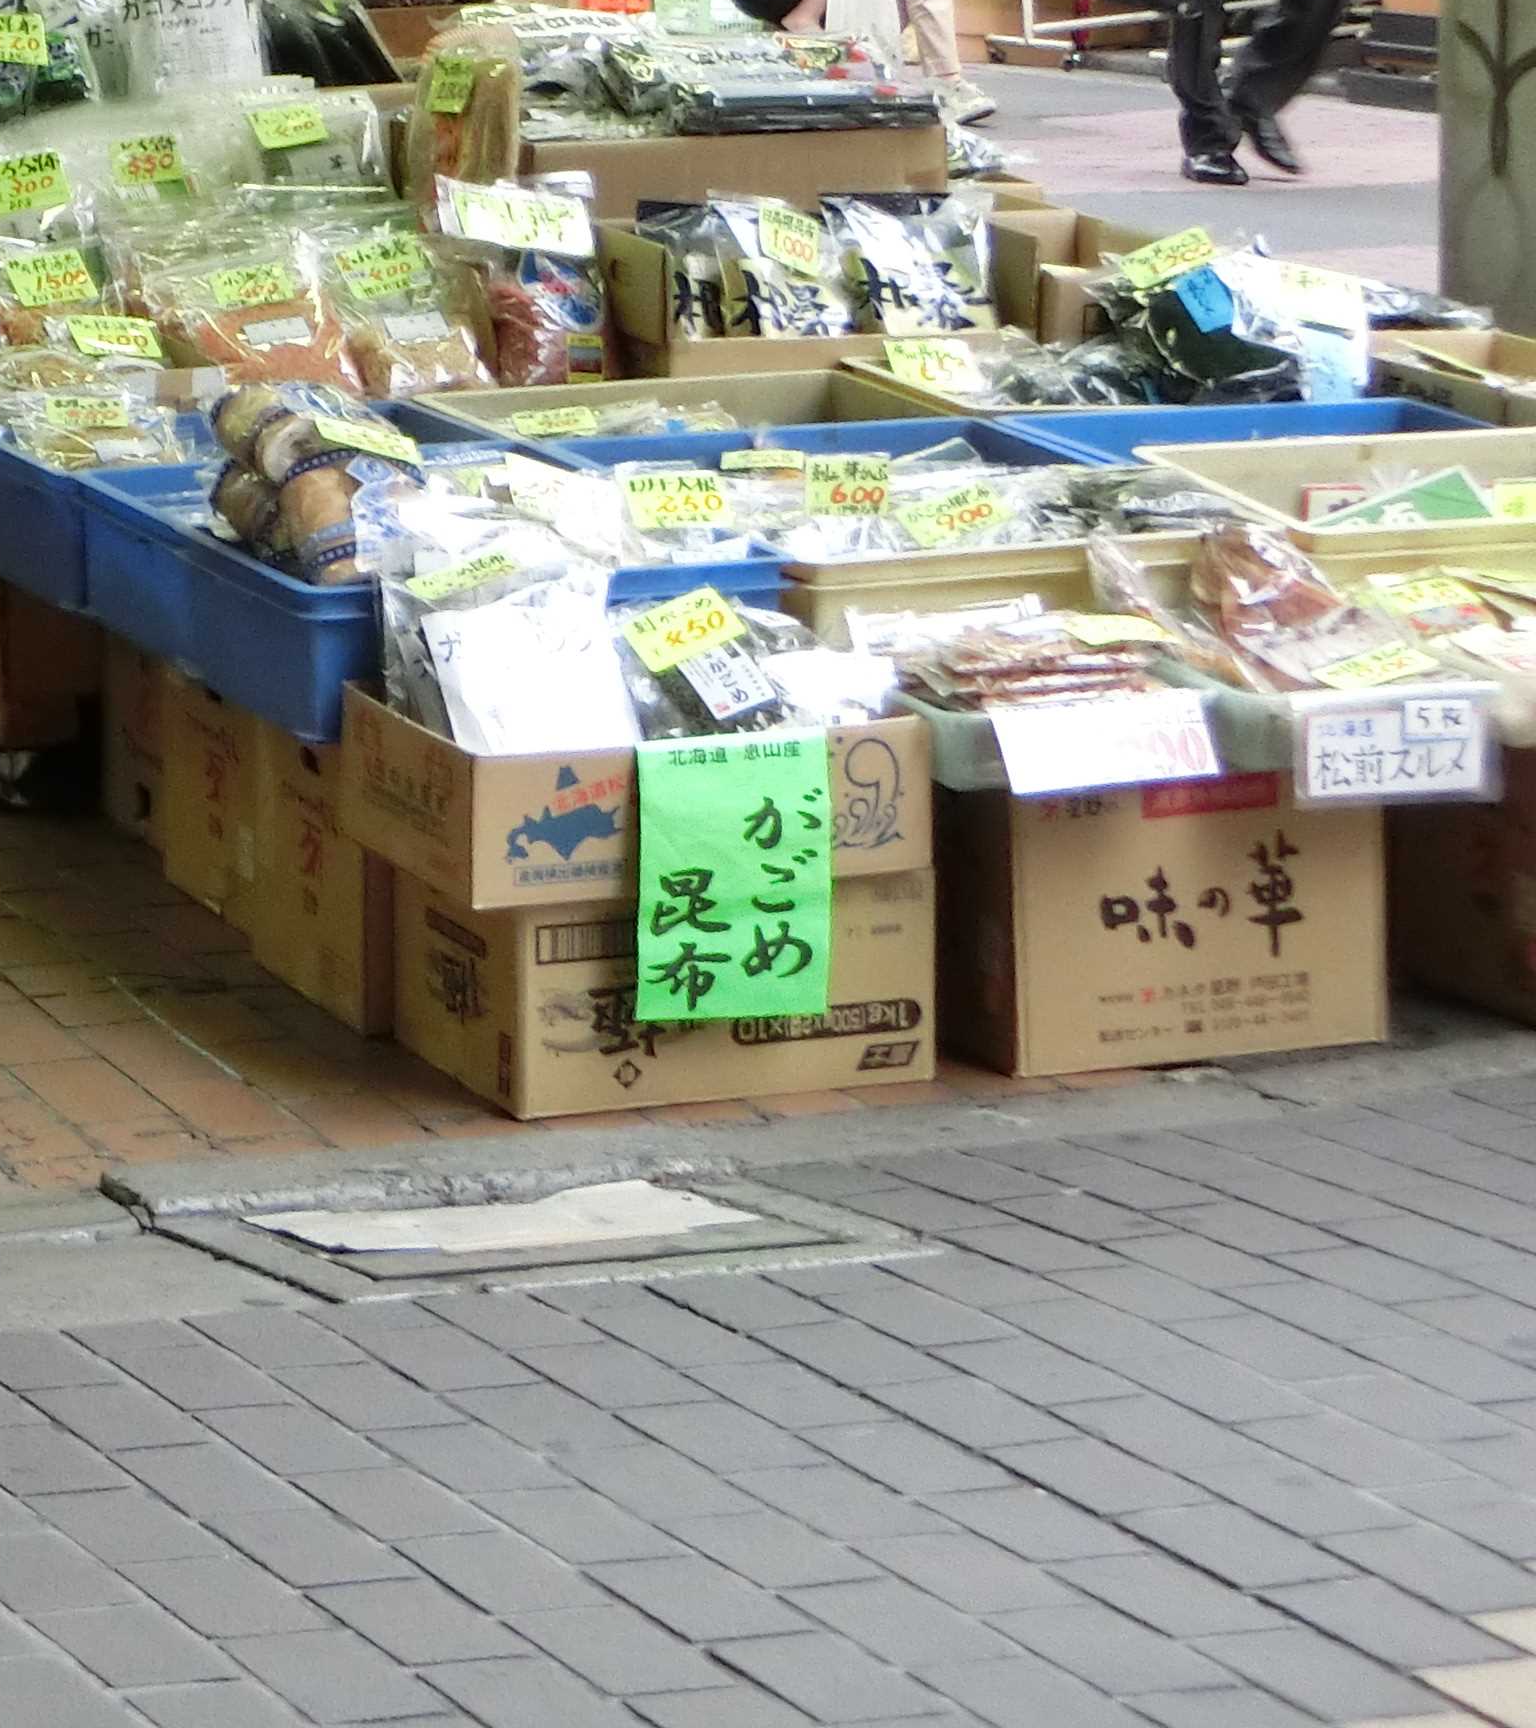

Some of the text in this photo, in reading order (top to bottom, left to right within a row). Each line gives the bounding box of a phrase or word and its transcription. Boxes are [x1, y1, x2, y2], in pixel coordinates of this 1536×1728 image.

[830, 483, 886, 506] 600
[667, 747, 728, 765] 北海道
[1314, 745, 1467, 789] 松前スルメ
[647, 787, 826, 1012] がごめ 昆布
